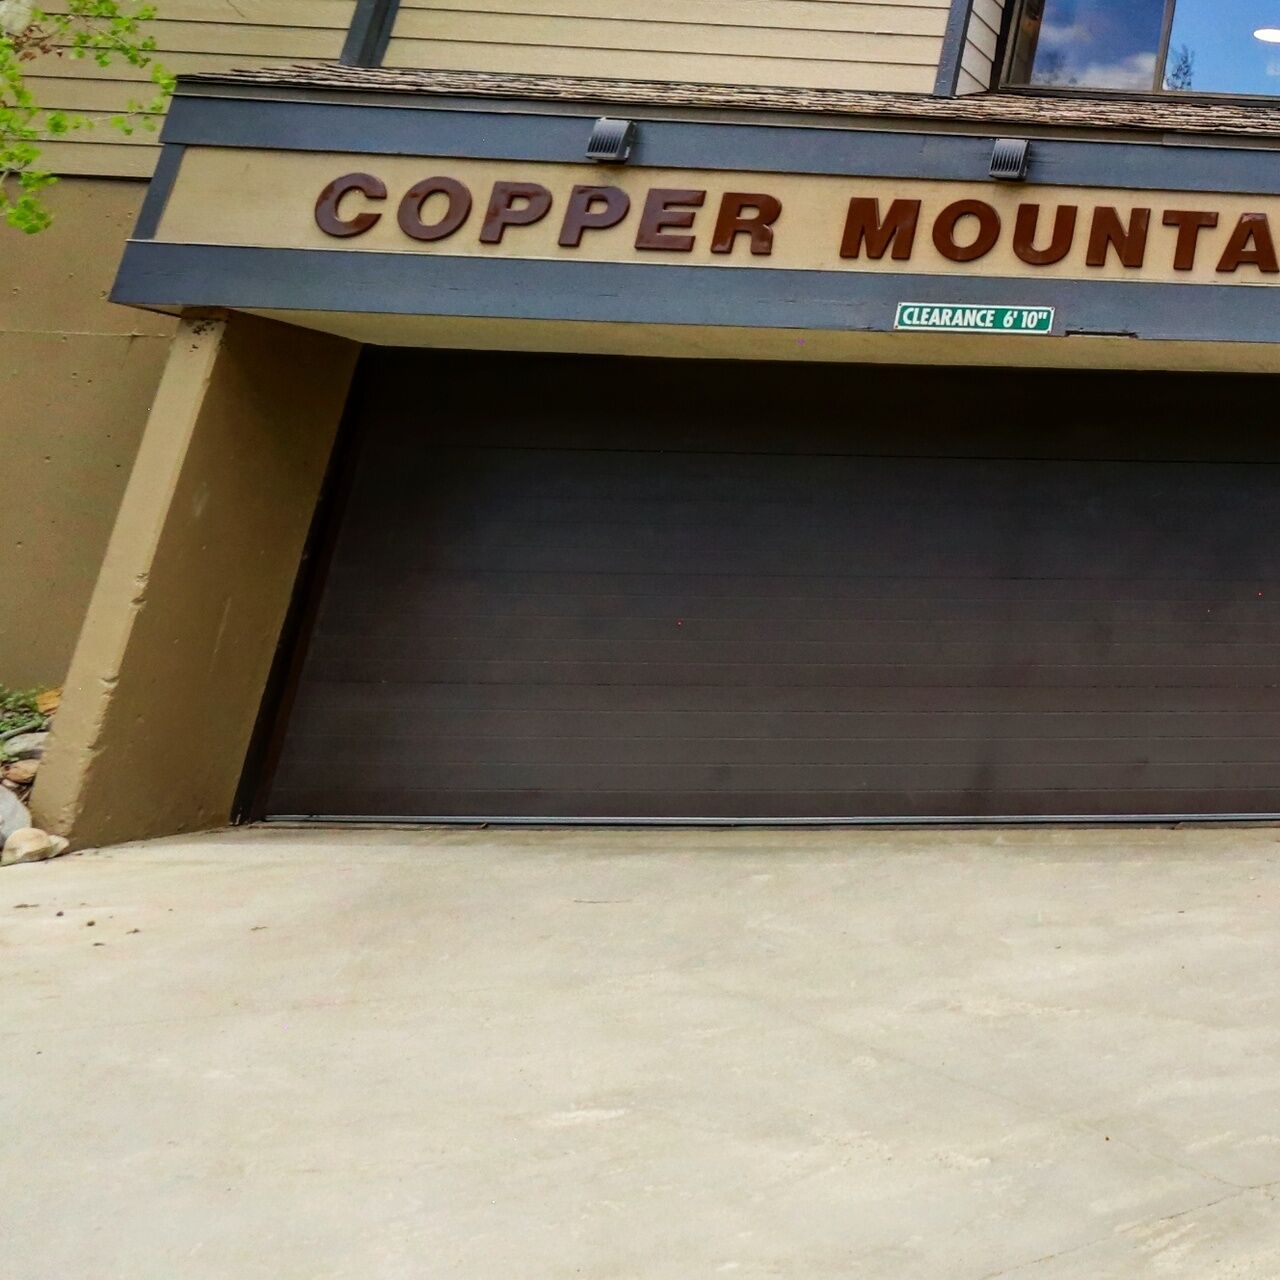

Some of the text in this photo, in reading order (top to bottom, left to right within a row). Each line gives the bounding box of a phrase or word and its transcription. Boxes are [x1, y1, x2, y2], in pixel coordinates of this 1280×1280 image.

[313, 172, 782, 255] COPPER
[902, 307, 996, 328] CLEARANCE
[1002, 311, 1018, 328] 6'
